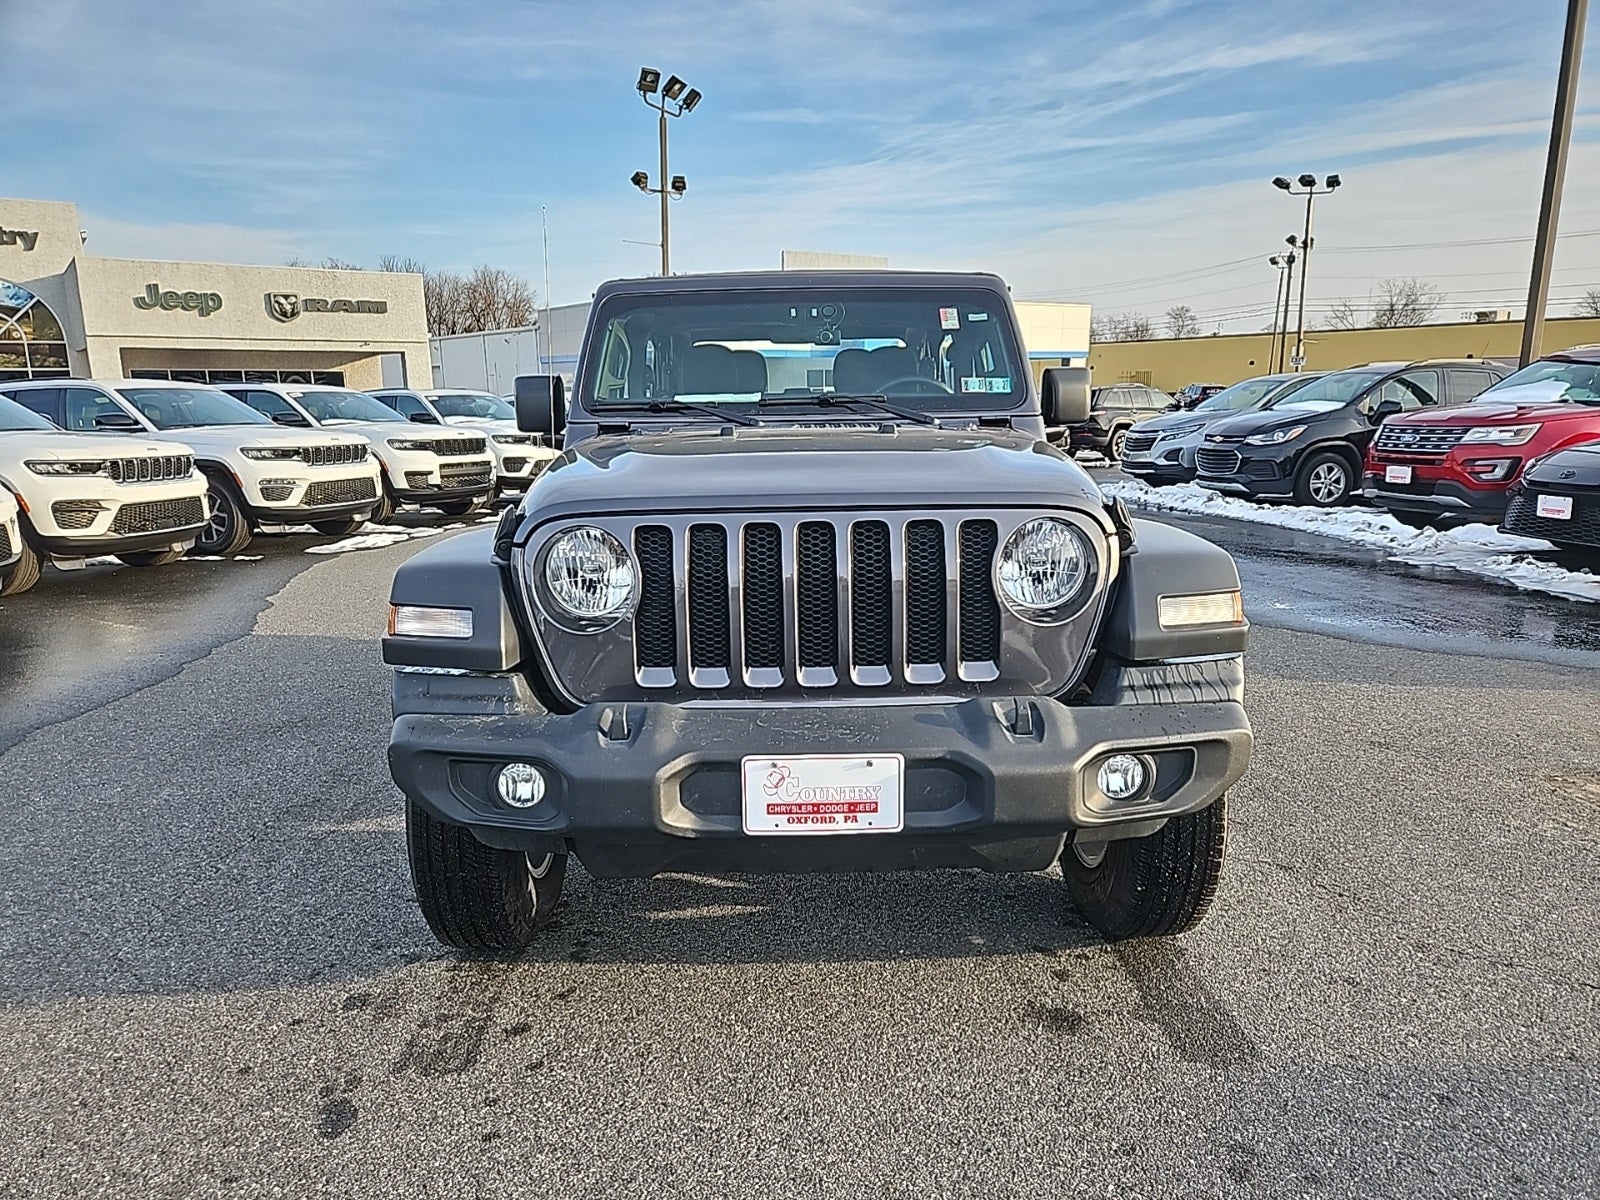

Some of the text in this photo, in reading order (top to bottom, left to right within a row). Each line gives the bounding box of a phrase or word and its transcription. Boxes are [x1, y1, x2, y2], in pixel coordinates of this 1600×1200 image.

[133, 284, 223, 317] Jeep
[304, 298, 388, 314] RAM
[768, 804, 877, 814] CHRYSLER DODGE JEEP
[787, 815, 859, 825] OXFORD, PA
